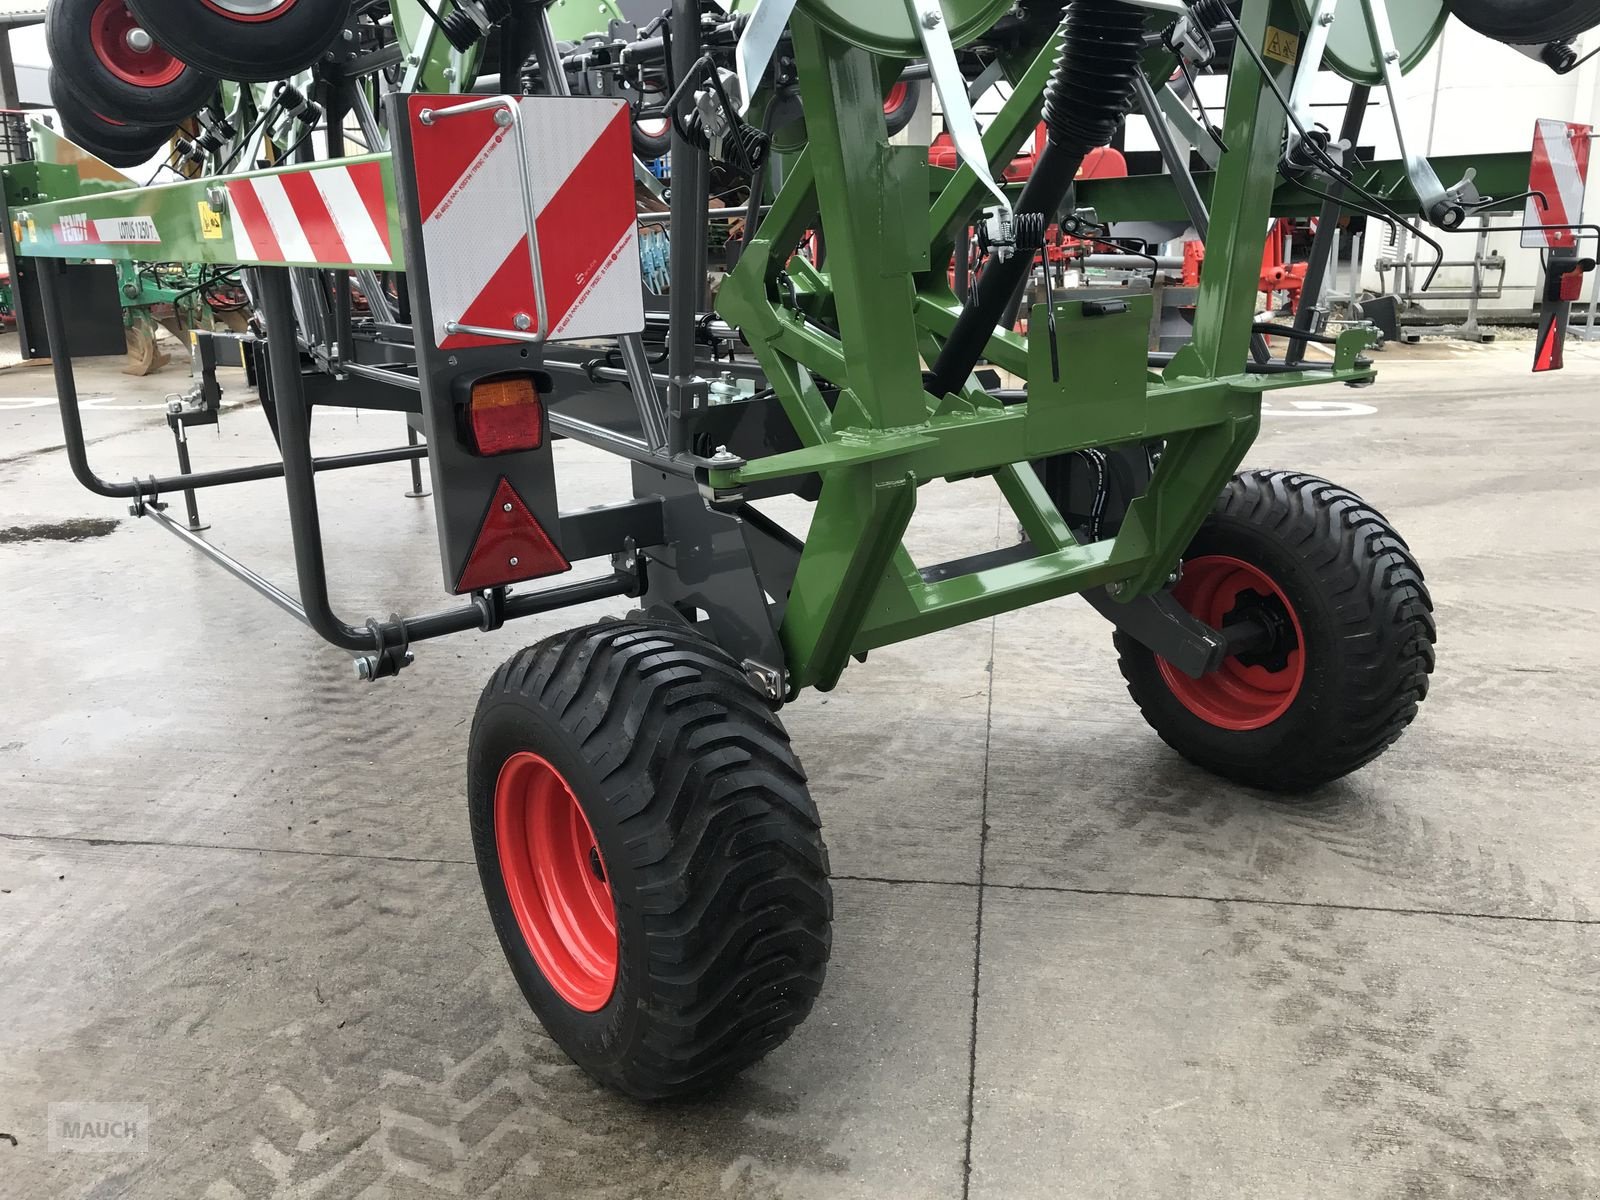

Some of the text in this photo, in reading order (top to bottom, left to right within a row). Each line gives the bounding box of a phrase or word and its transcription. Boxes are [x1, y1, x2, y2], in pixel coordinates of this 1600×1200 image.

[59, 213, 88, 242] FENDT
[118, 222, 135, 239] LOTUS
[135, 221, 150, 239] 1250
